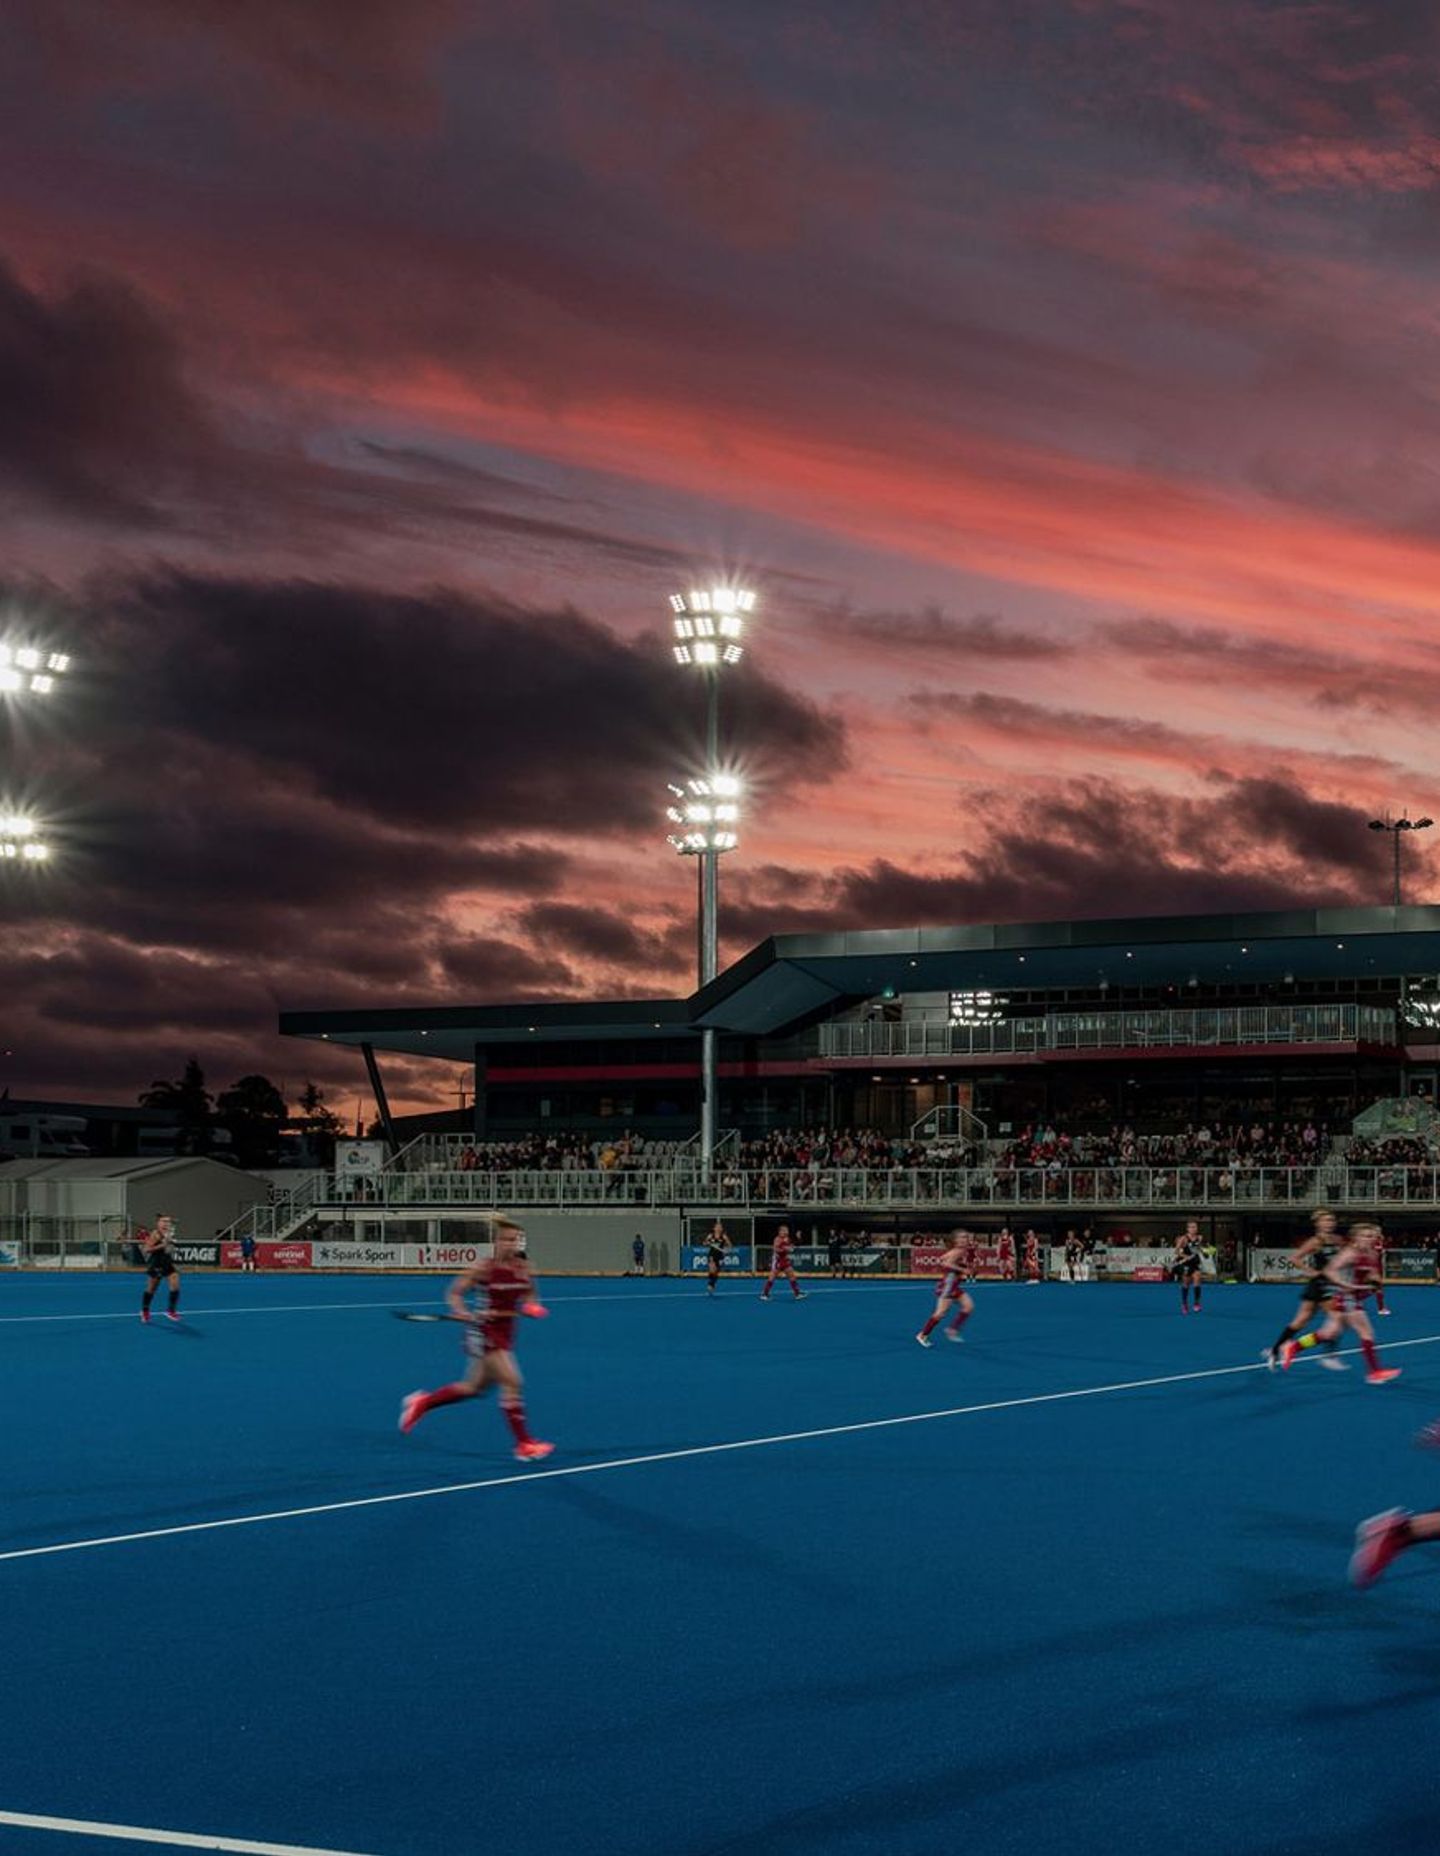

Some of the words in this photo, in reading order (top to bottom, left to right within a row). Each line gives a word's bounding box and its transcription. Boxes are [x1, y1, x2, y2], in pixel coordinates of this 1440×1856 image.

[332, 1248, 363, 1261] Spark
[365, 1248, 395, 1262] Sport
[693, 1255, 740, 1267] poan
